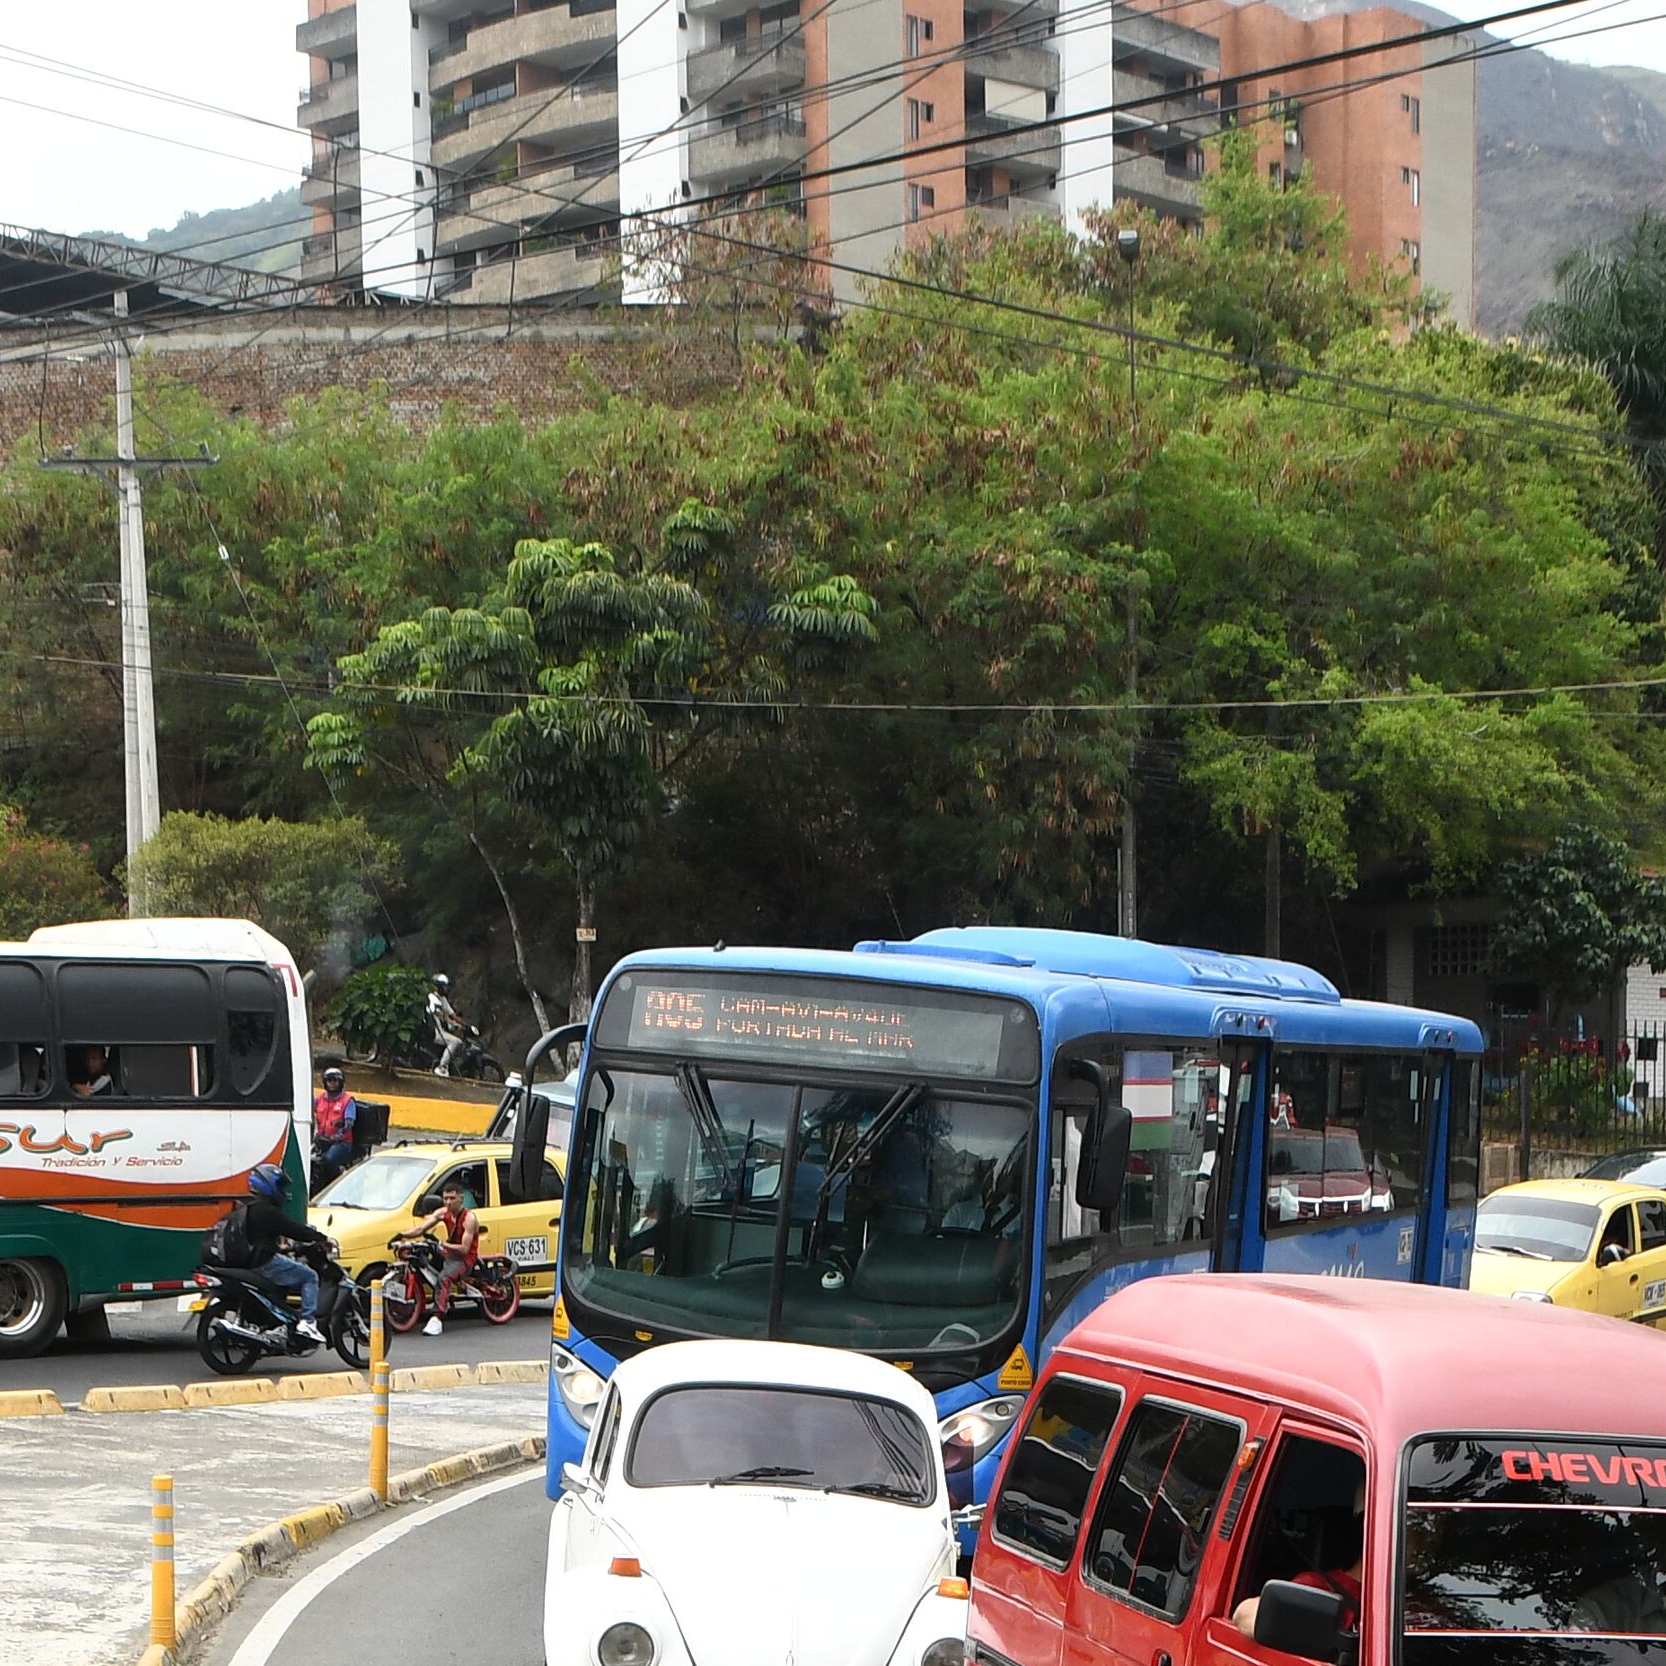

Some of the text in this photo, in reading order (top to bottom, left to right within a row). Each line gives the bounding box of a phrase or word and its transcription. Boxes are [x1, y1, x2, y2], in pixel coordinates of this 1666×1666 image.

[125, 1155, 183, 1167] Servicio
[507, 1238, 546, 1256] VCS 631
